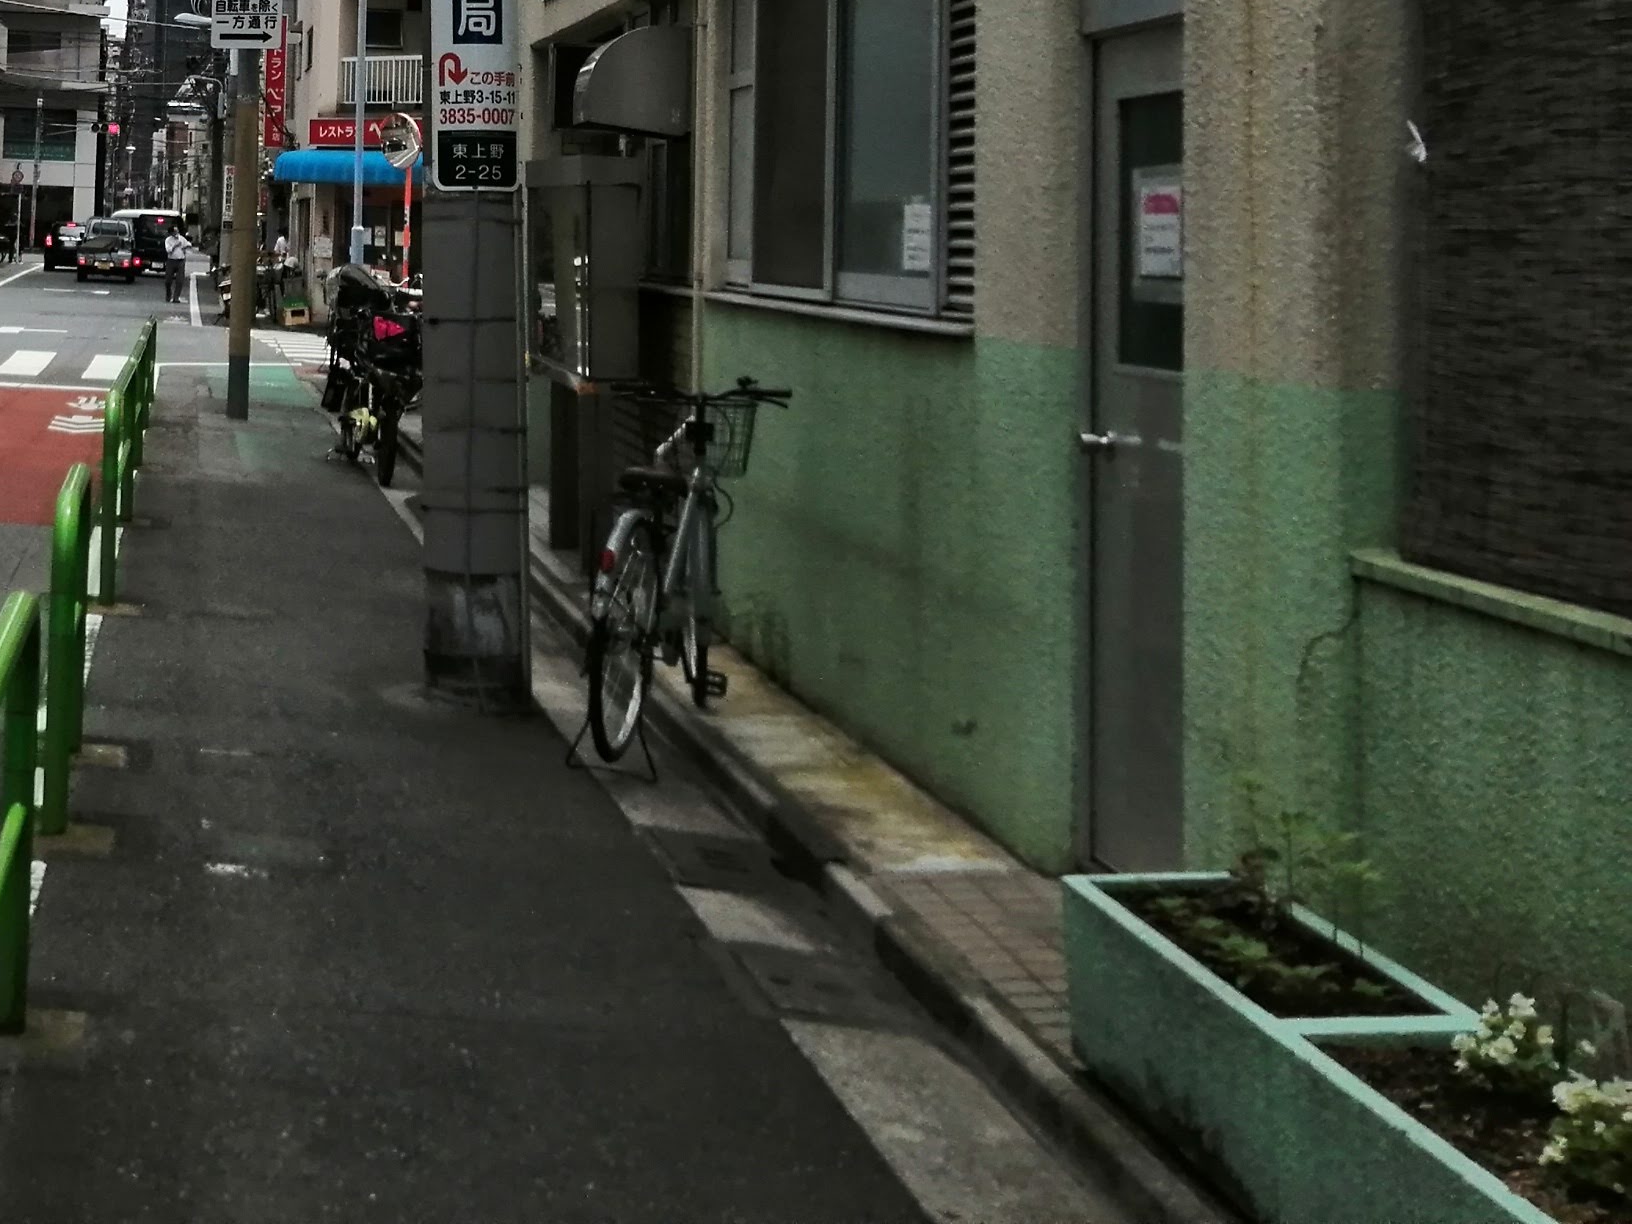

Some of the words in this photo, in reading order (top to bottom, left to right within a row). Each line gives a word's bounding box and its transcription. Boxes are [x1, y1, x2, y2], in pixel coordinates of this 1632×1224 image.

[215, 0, 278, 13] 自転車を除く
[216, 16, 278, 29] 一方通行
[469, 72, 515, 87] この手前
[439, 90, 515, 105] 東上野3-15-11
[439, 108, 515, 125] 3835-0007
[319, 126, 357, 138] レストラ
[452, 143, 504, 159] 東上野
[455, 165, 502, 180] 2-25
